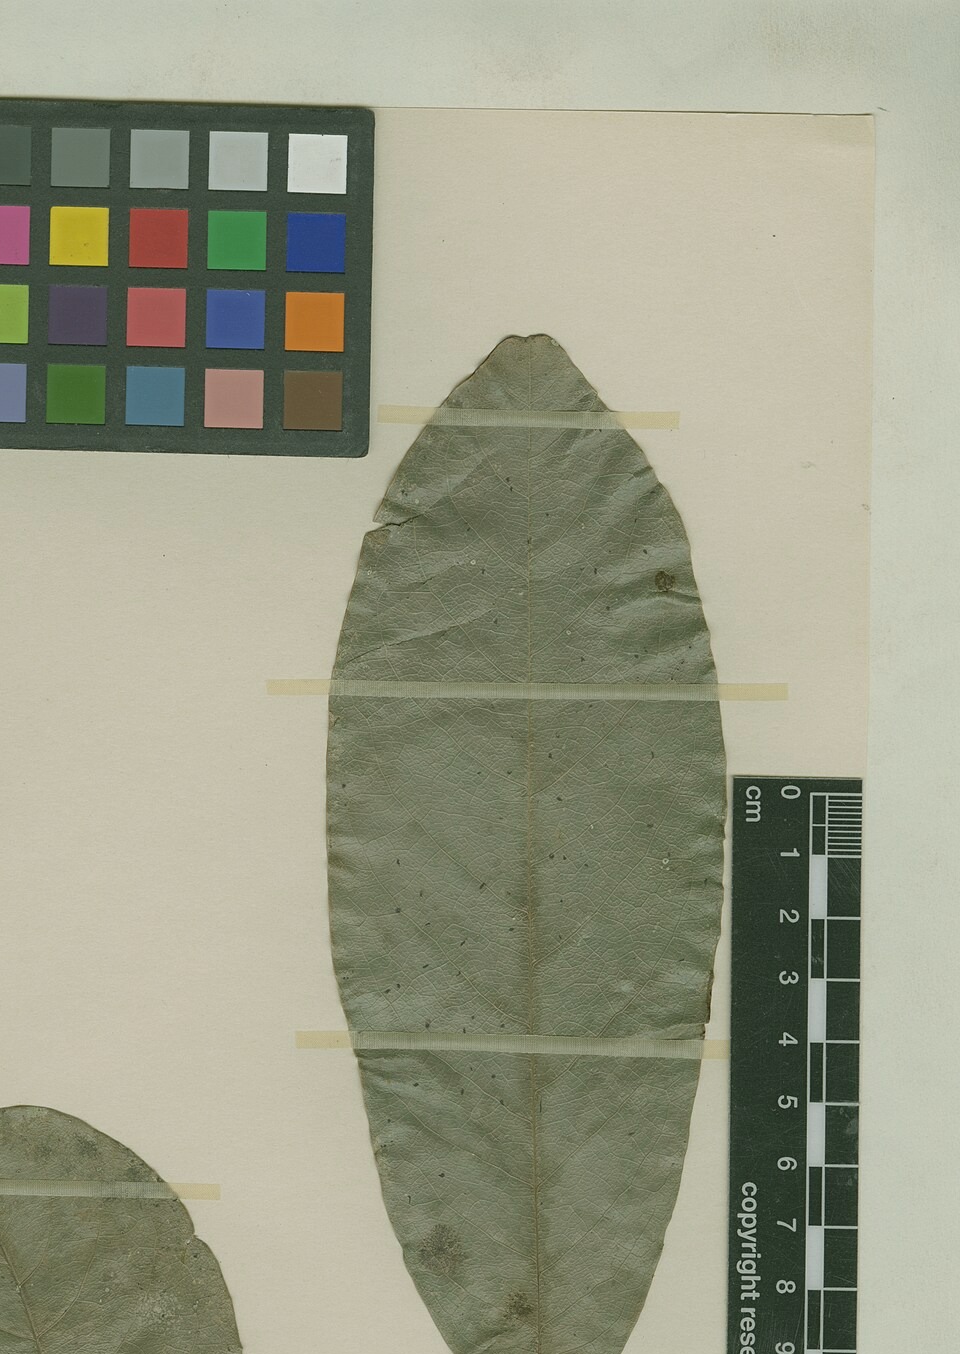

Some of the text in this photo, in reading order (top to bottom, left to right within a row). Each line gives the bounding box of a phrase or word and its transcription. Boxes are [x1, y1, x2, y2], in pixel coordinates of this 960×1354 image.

[780, 785, 801, 800] 0
[745, 785, 762, 823] cm
[780, 848, 801, 857] 1
[779, 909, 800, 924] 2
[778, 970, 799, 985] 3
[778, 1032, 798, 1047] 4
[777, 1095, 798, 1109] 5
[777, 1156, 798, 1171] 6
[776, 1218, 797, 1232] 7
[736, 1181, 762, 1301] copyright
[775, 1279, 796, 1294] 8
